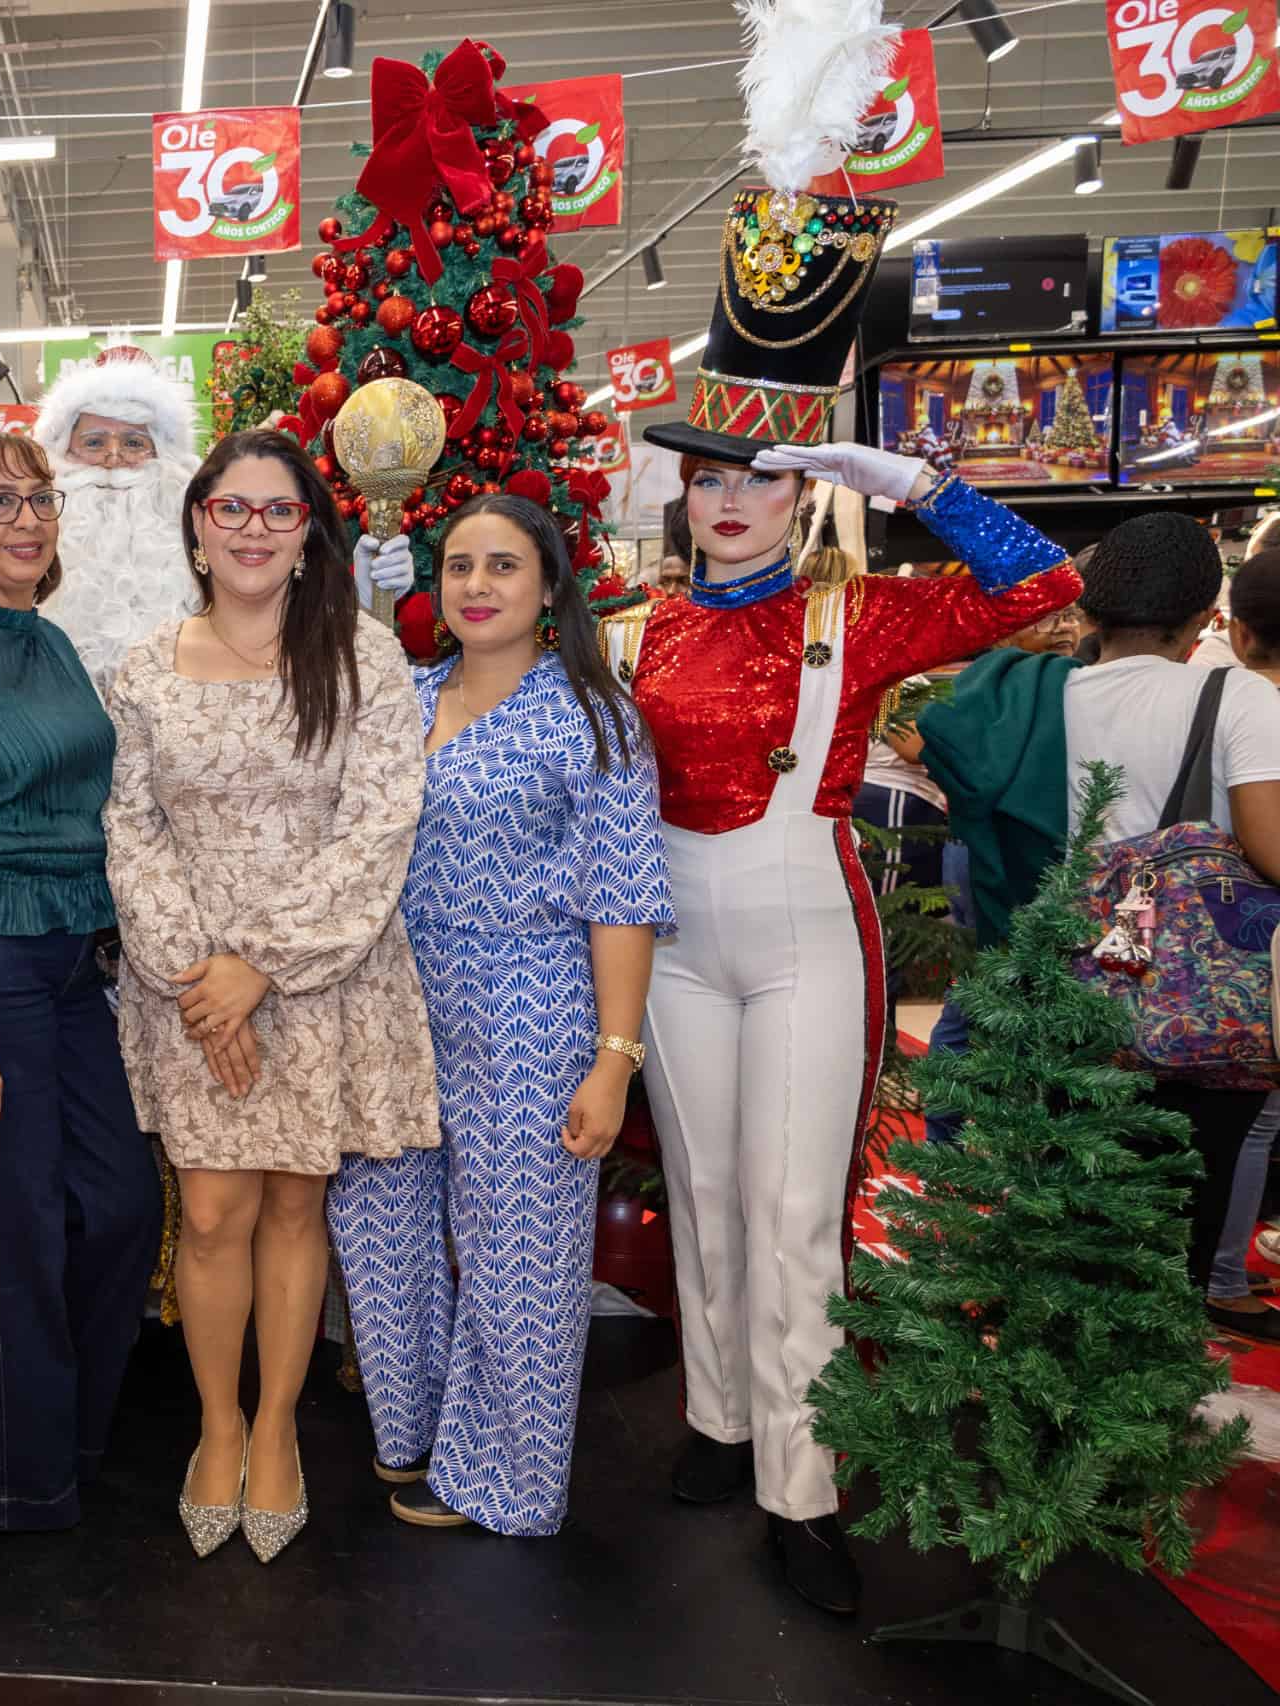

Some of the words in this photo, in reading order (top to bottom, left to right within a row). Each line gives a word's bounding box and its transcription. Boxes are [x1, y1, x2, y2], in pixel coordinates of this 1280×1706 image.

[1116, 8, 1254, 118] 30
[1184, 94, 1218, 108] AÑOS
[161, 121, 217, 150] Olé
[849, 158, 880, 170] AÑOS
[882, 131, 926, 168] CONTIGO
[158, 147, 279, 237] 30
[216, 224, 244, 237] AÑOS
[246, 207, 287, 235] CONTIGO
[612, 358, 664, 402] 30
